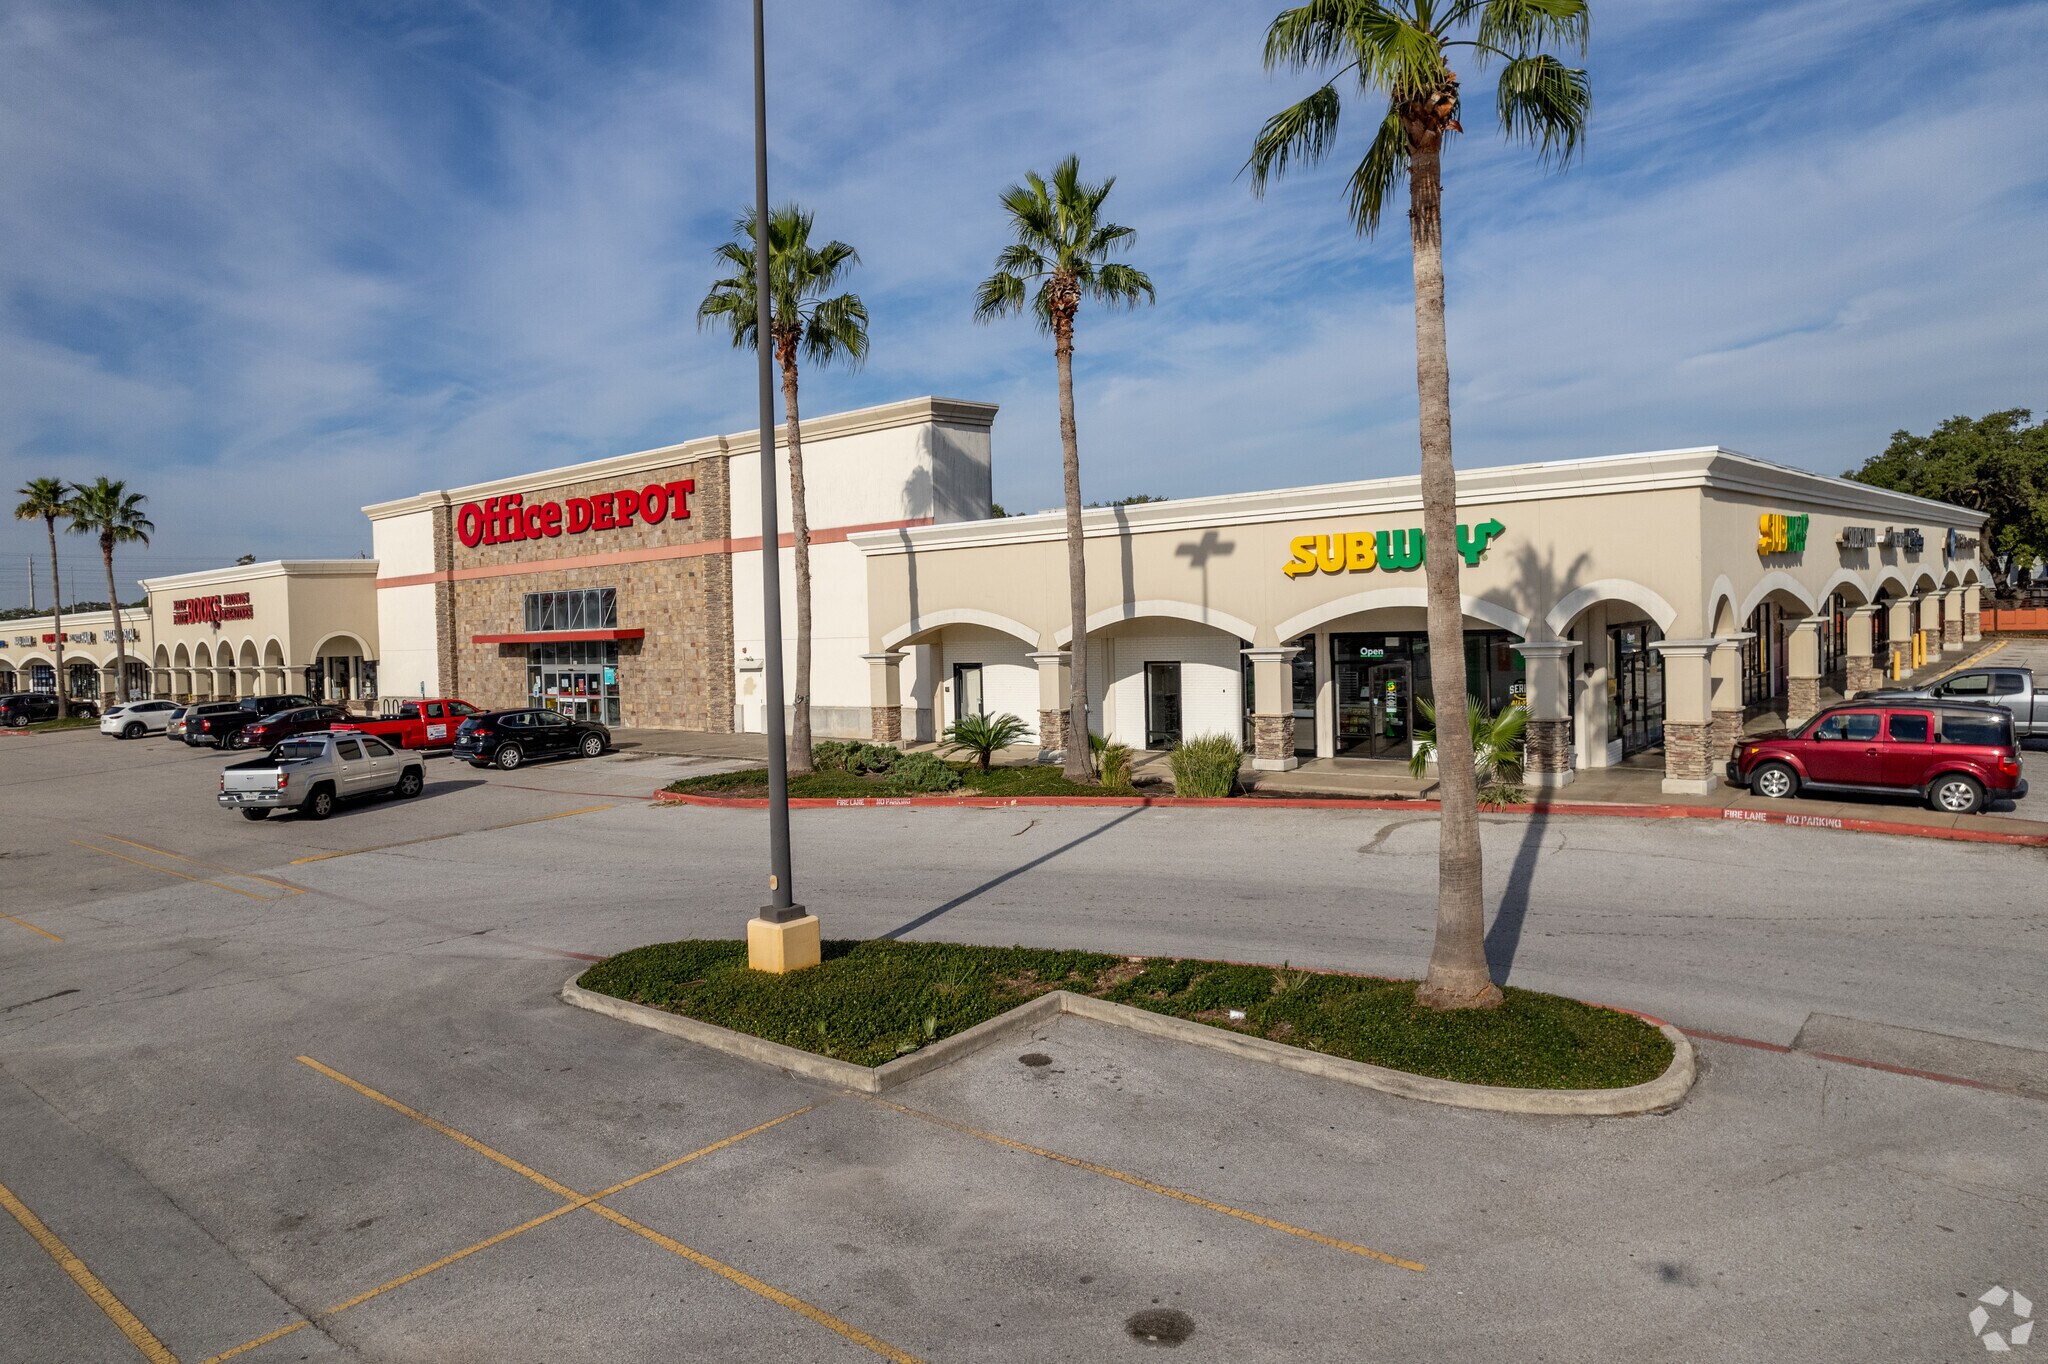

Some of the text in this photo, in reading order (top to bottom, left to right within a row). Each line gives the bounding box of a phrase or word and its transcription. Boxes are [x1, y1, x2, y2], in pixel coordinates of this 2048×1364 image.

[457, 479, 696, 548] Office DEPOT
[1281, 517, 1506, 579] SUBWY
[187, 595, 222, 625] BOOKS
[1360, 647, 1384, 658] Open
[849, 798, 865, 806] LANE
[875, 798, 885, 806] NO
[885, 797, 911, 805] PARKING
[1724, 809, 1842, 828] FIRE LANE NO PARKING
